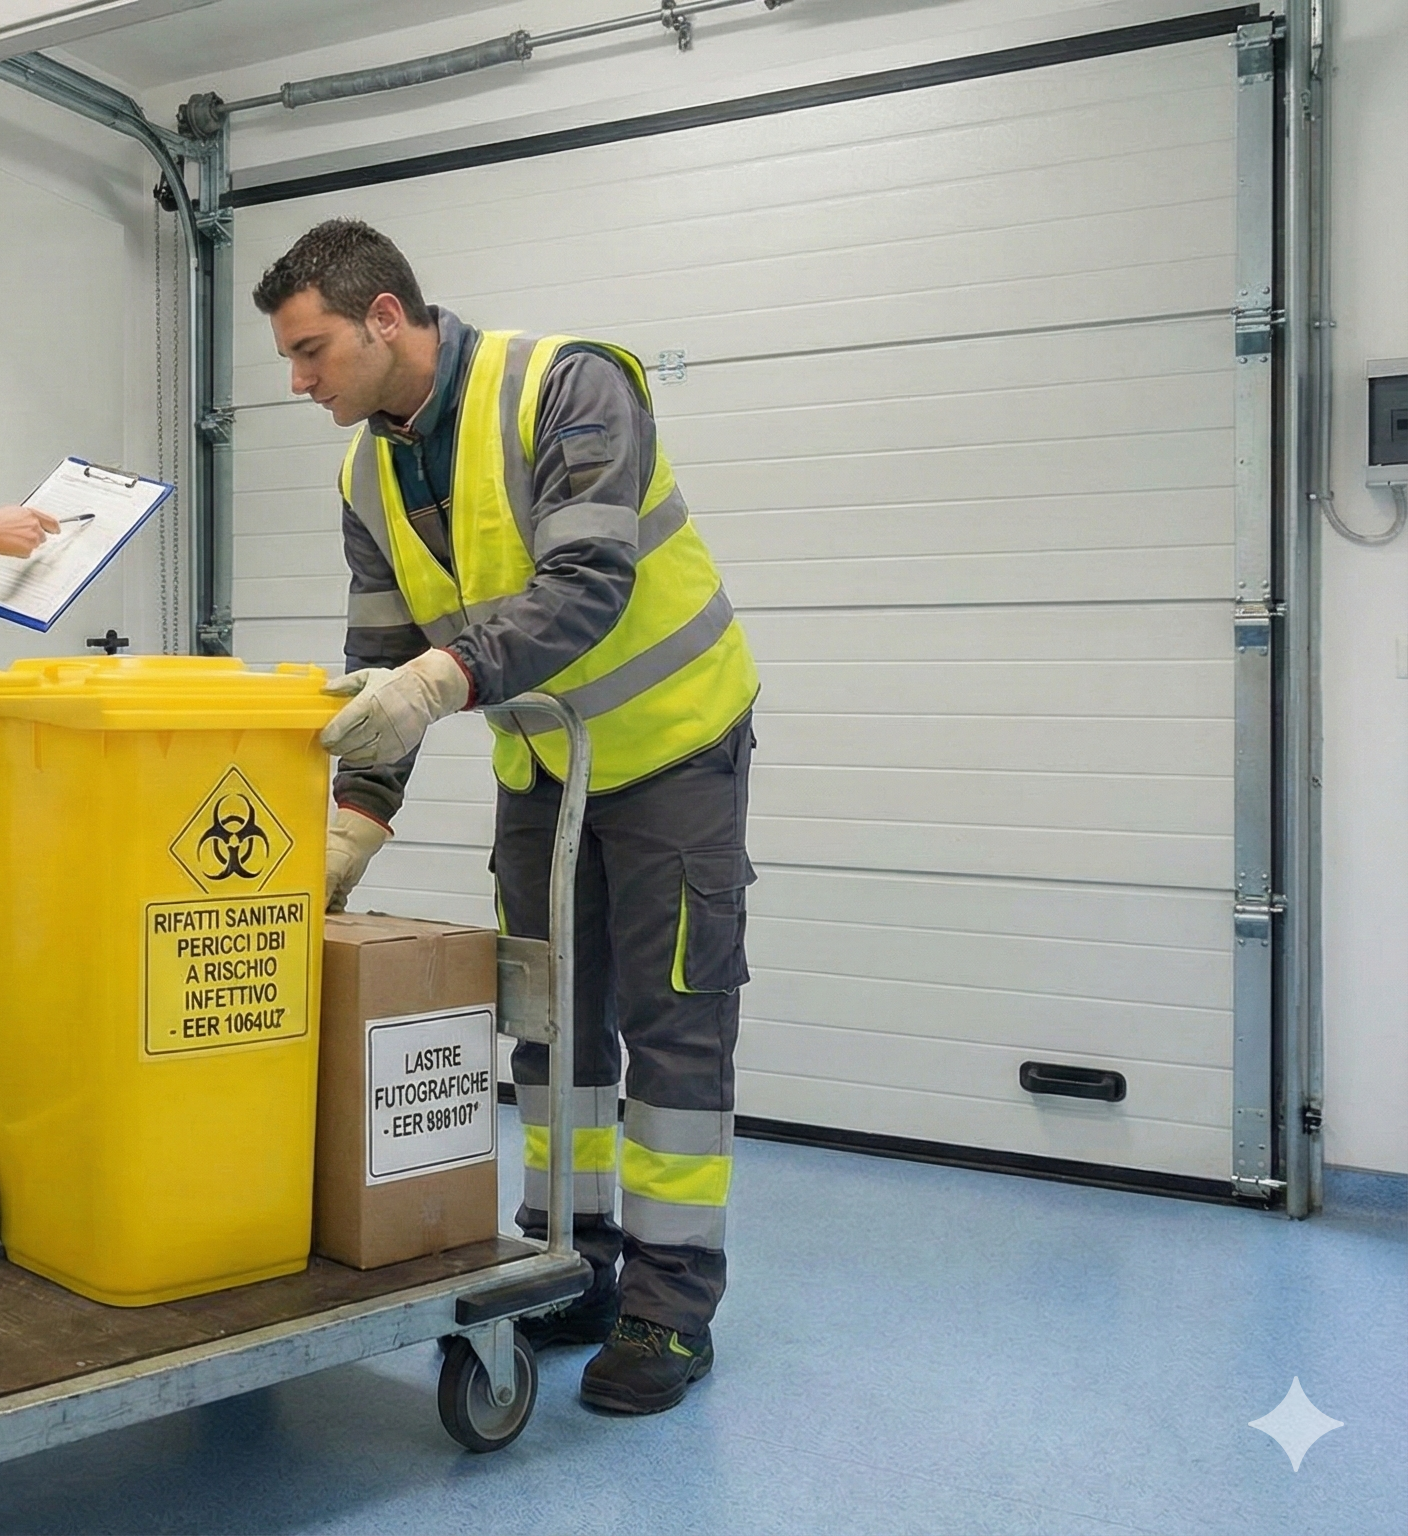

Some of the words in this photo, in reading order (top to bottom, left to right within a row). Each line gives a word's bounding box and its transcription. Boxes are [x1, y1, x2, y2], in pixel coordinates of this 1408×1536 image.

[154, 908, 220, 934] RIFATTI
[225, 902, 304, 928] SANITARI
[177, 933, 251, 958] PERICCI
[256, 930, 286, 952] DBI
[185, 964, 200, 985] A
[204, 956, 278, 982] RISCHIO
[185, 983, 278, 1011] INFETTIVO
[183, 1016, 220, 1039] EER
[405, 1045, 462, 1075] LASTRE
[374, 1070, 489, 1110] FUTOGRAFICHE
[392, 1112, 424, 1138] EER
